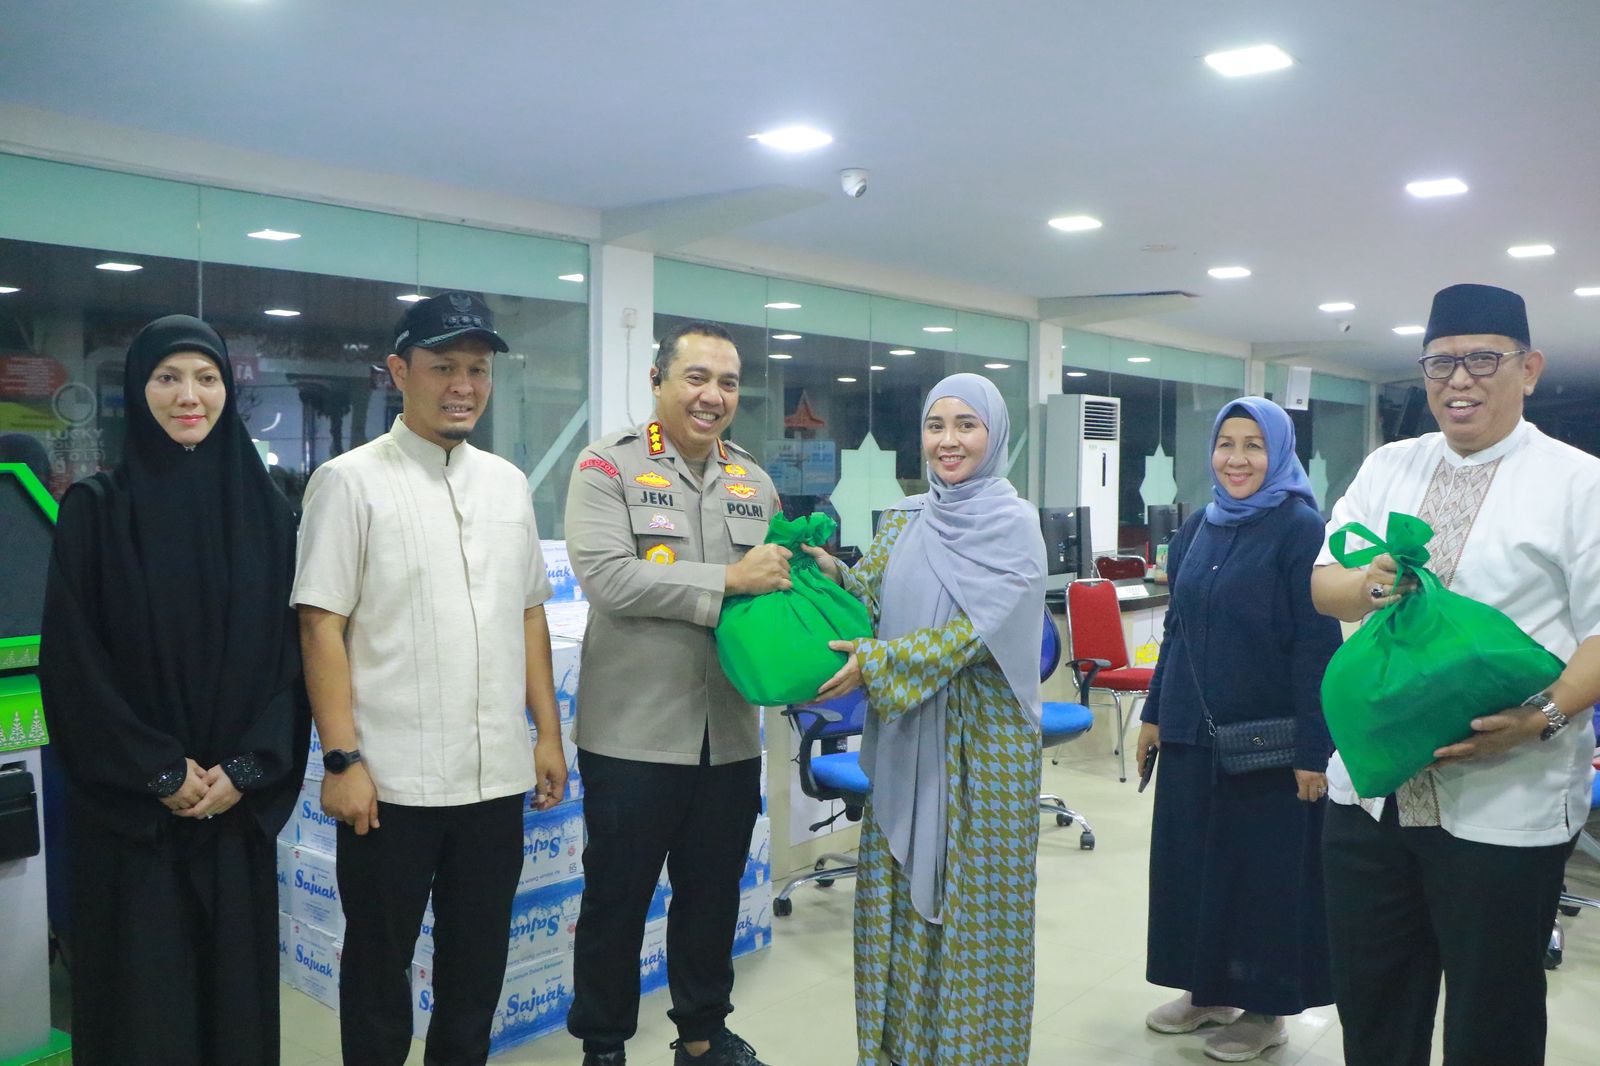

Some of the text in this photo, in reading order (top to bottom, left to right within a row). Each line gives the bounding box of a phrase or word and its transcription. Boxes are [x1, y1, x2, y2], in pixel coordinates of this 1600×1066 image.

[640, 490, 674, 507] JEKI
[726, 502, 764, 518] POLRI
[547, 566, 571, 578] uak
[303, 800, 337, 826] Sajua
[294, 868, 337, 901] Sajuak
[508, 914, 561, 943] Sajua
[295, 943, 333, 979] Sajuak
[506, 982, 568, 1017] Sajuak
